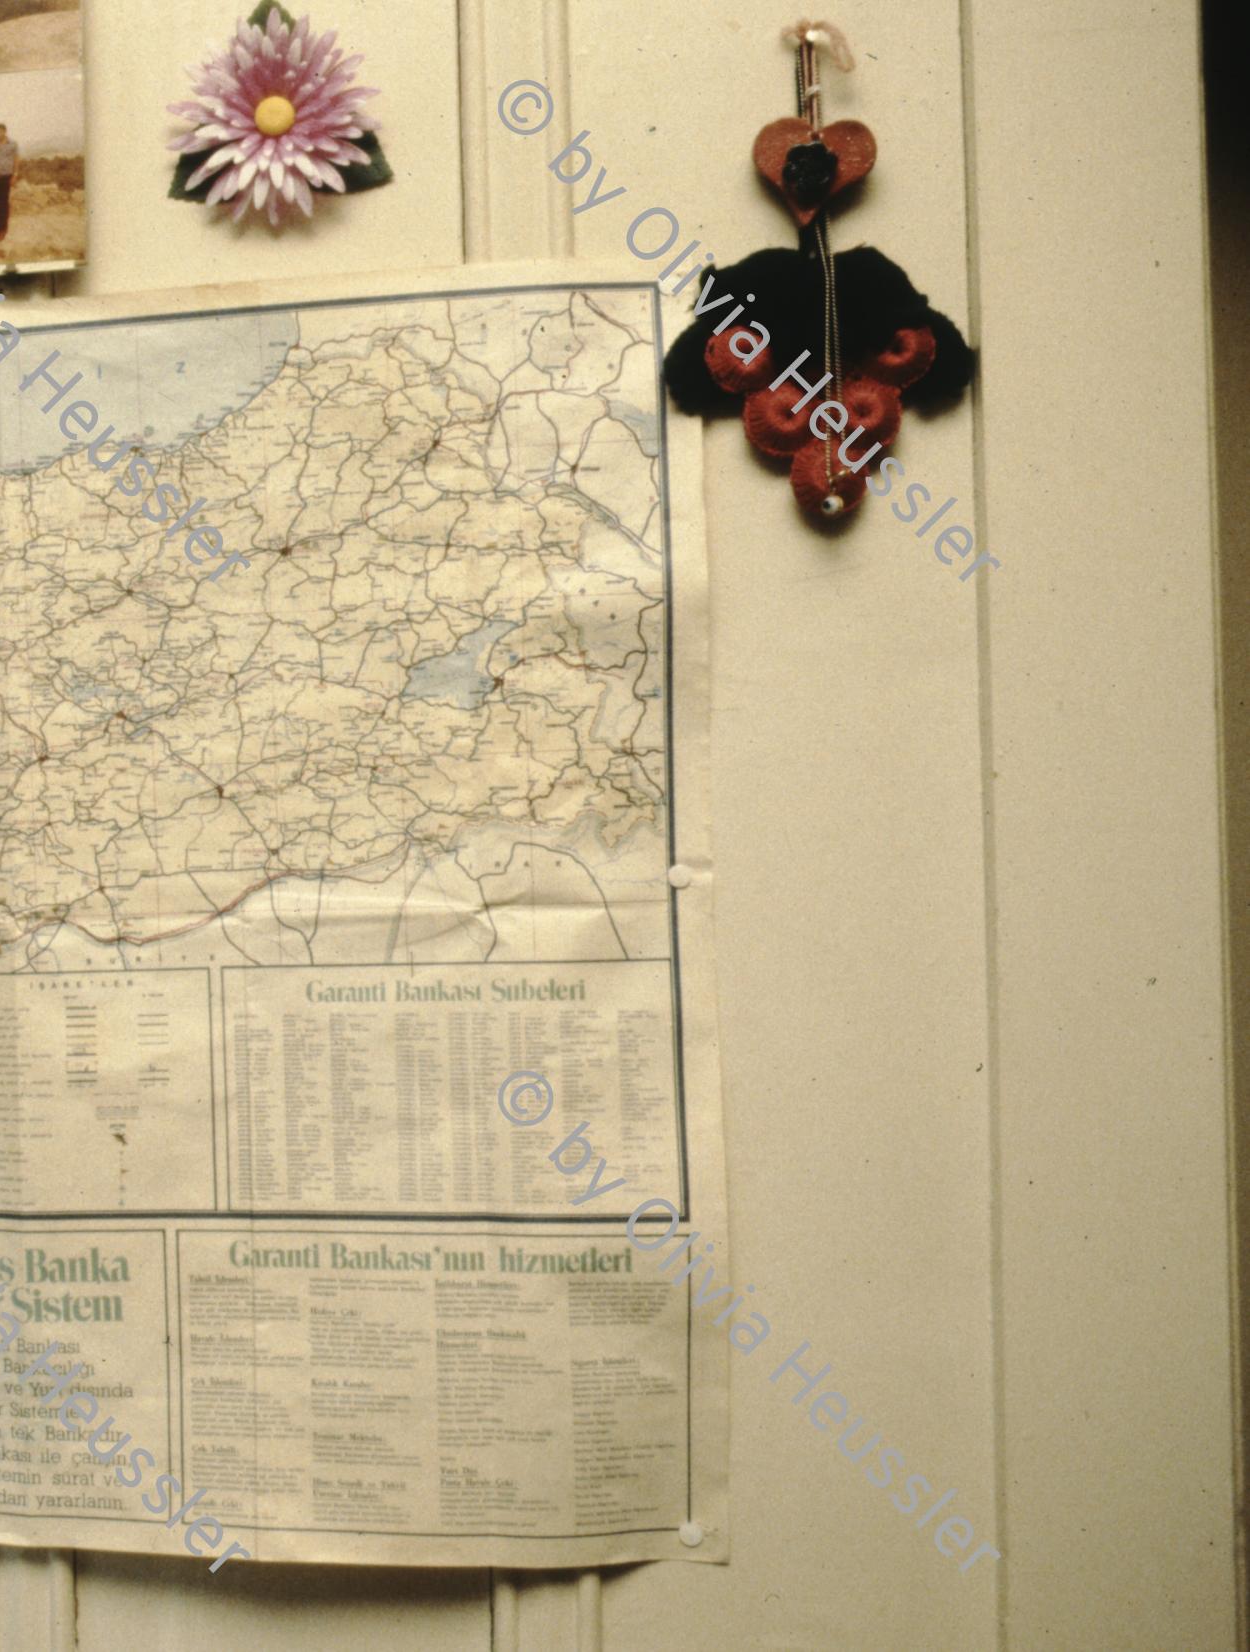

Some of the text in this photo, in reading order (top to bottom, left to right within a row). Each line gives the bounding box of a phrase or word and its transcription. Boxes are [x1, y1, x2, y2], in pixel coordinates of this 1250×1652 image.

[305, 980, 387, 1003] Garanti
[394, 979, 483, 1002] Bankası
[24, 1246, 131, 1284] Banka
[228, 1239, 320, 1269] Garanti
[499, 1246, 633, 1274] hizmetleri
[10, 1286, 124, 1324] Sistem
[4, 1382, 23, 1396] ve
[29, 1380, 63, 1397] Yur
[10, 1425, 35, 1441] tek
